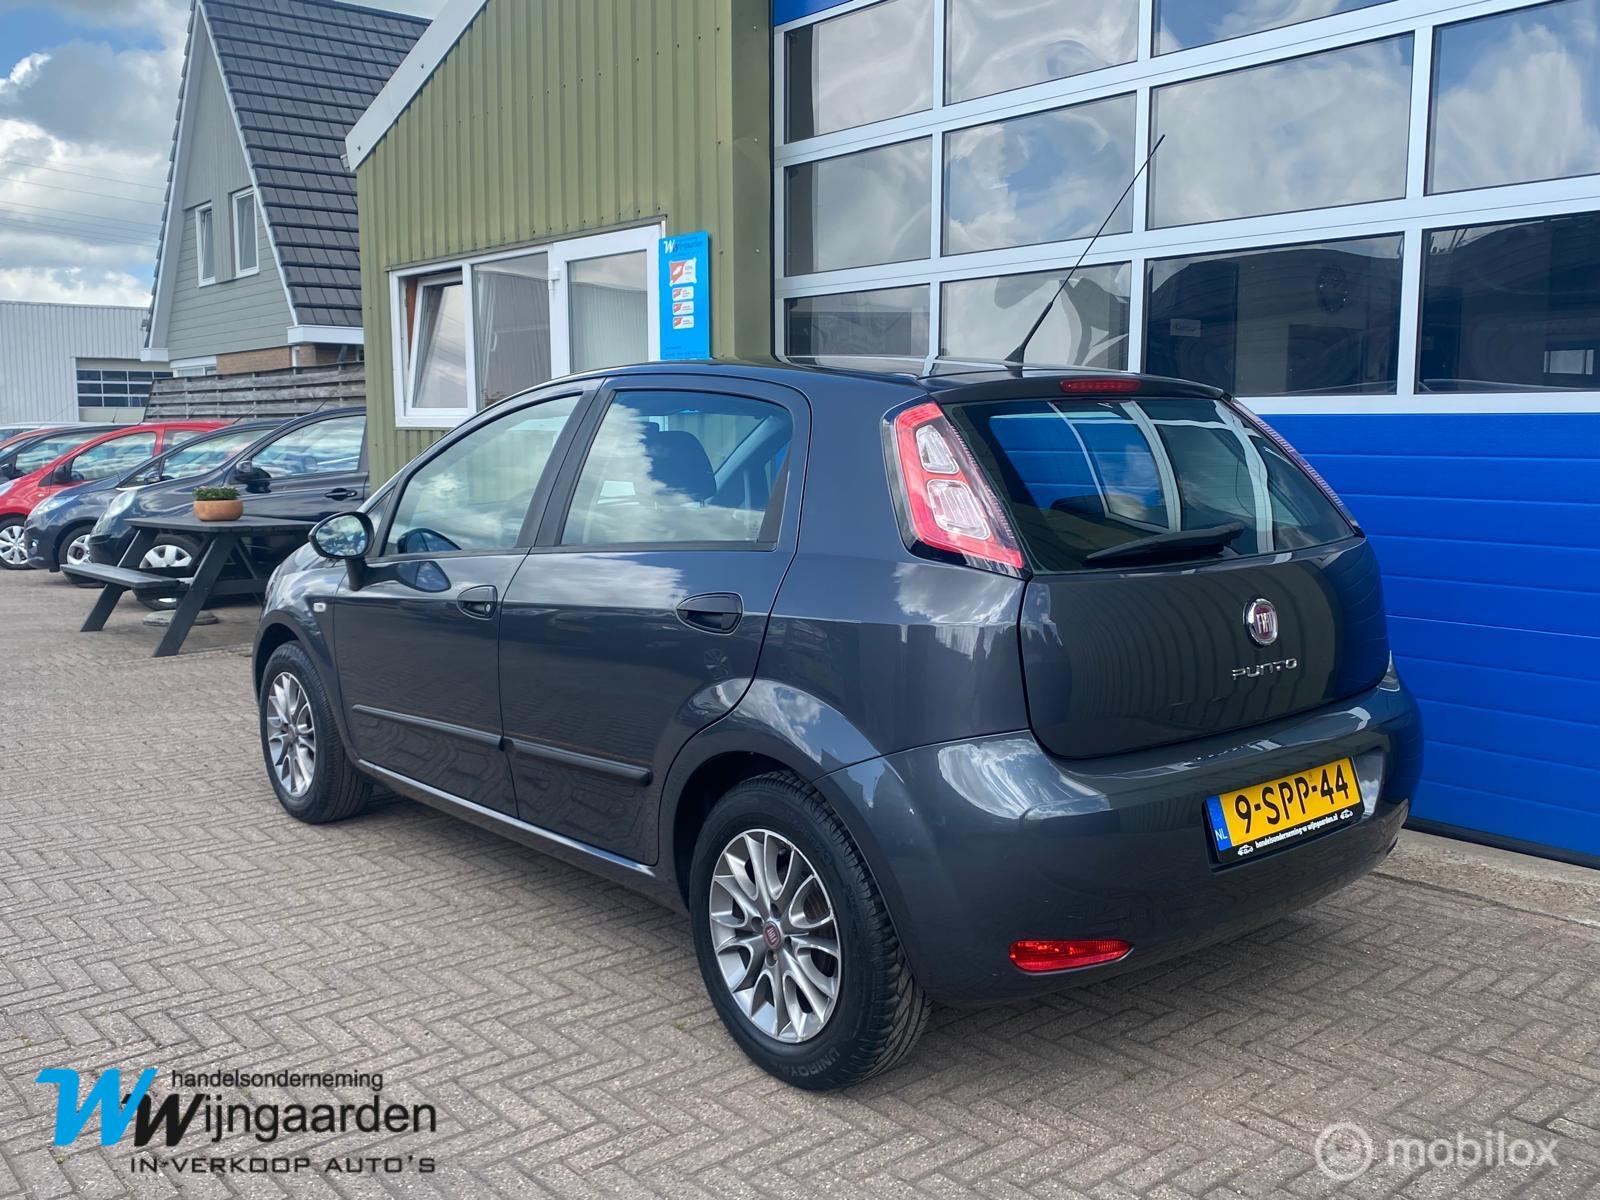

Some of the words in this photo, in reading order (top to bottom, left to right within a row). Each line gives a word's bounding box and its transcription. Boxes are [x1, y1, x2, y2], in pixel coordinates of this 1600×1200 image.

[1231, 658, 1297, 680] PUNTO
[1234, 764, 1349, 834] 9-SPP-44
[1215, 828, 1228, 841] NL
